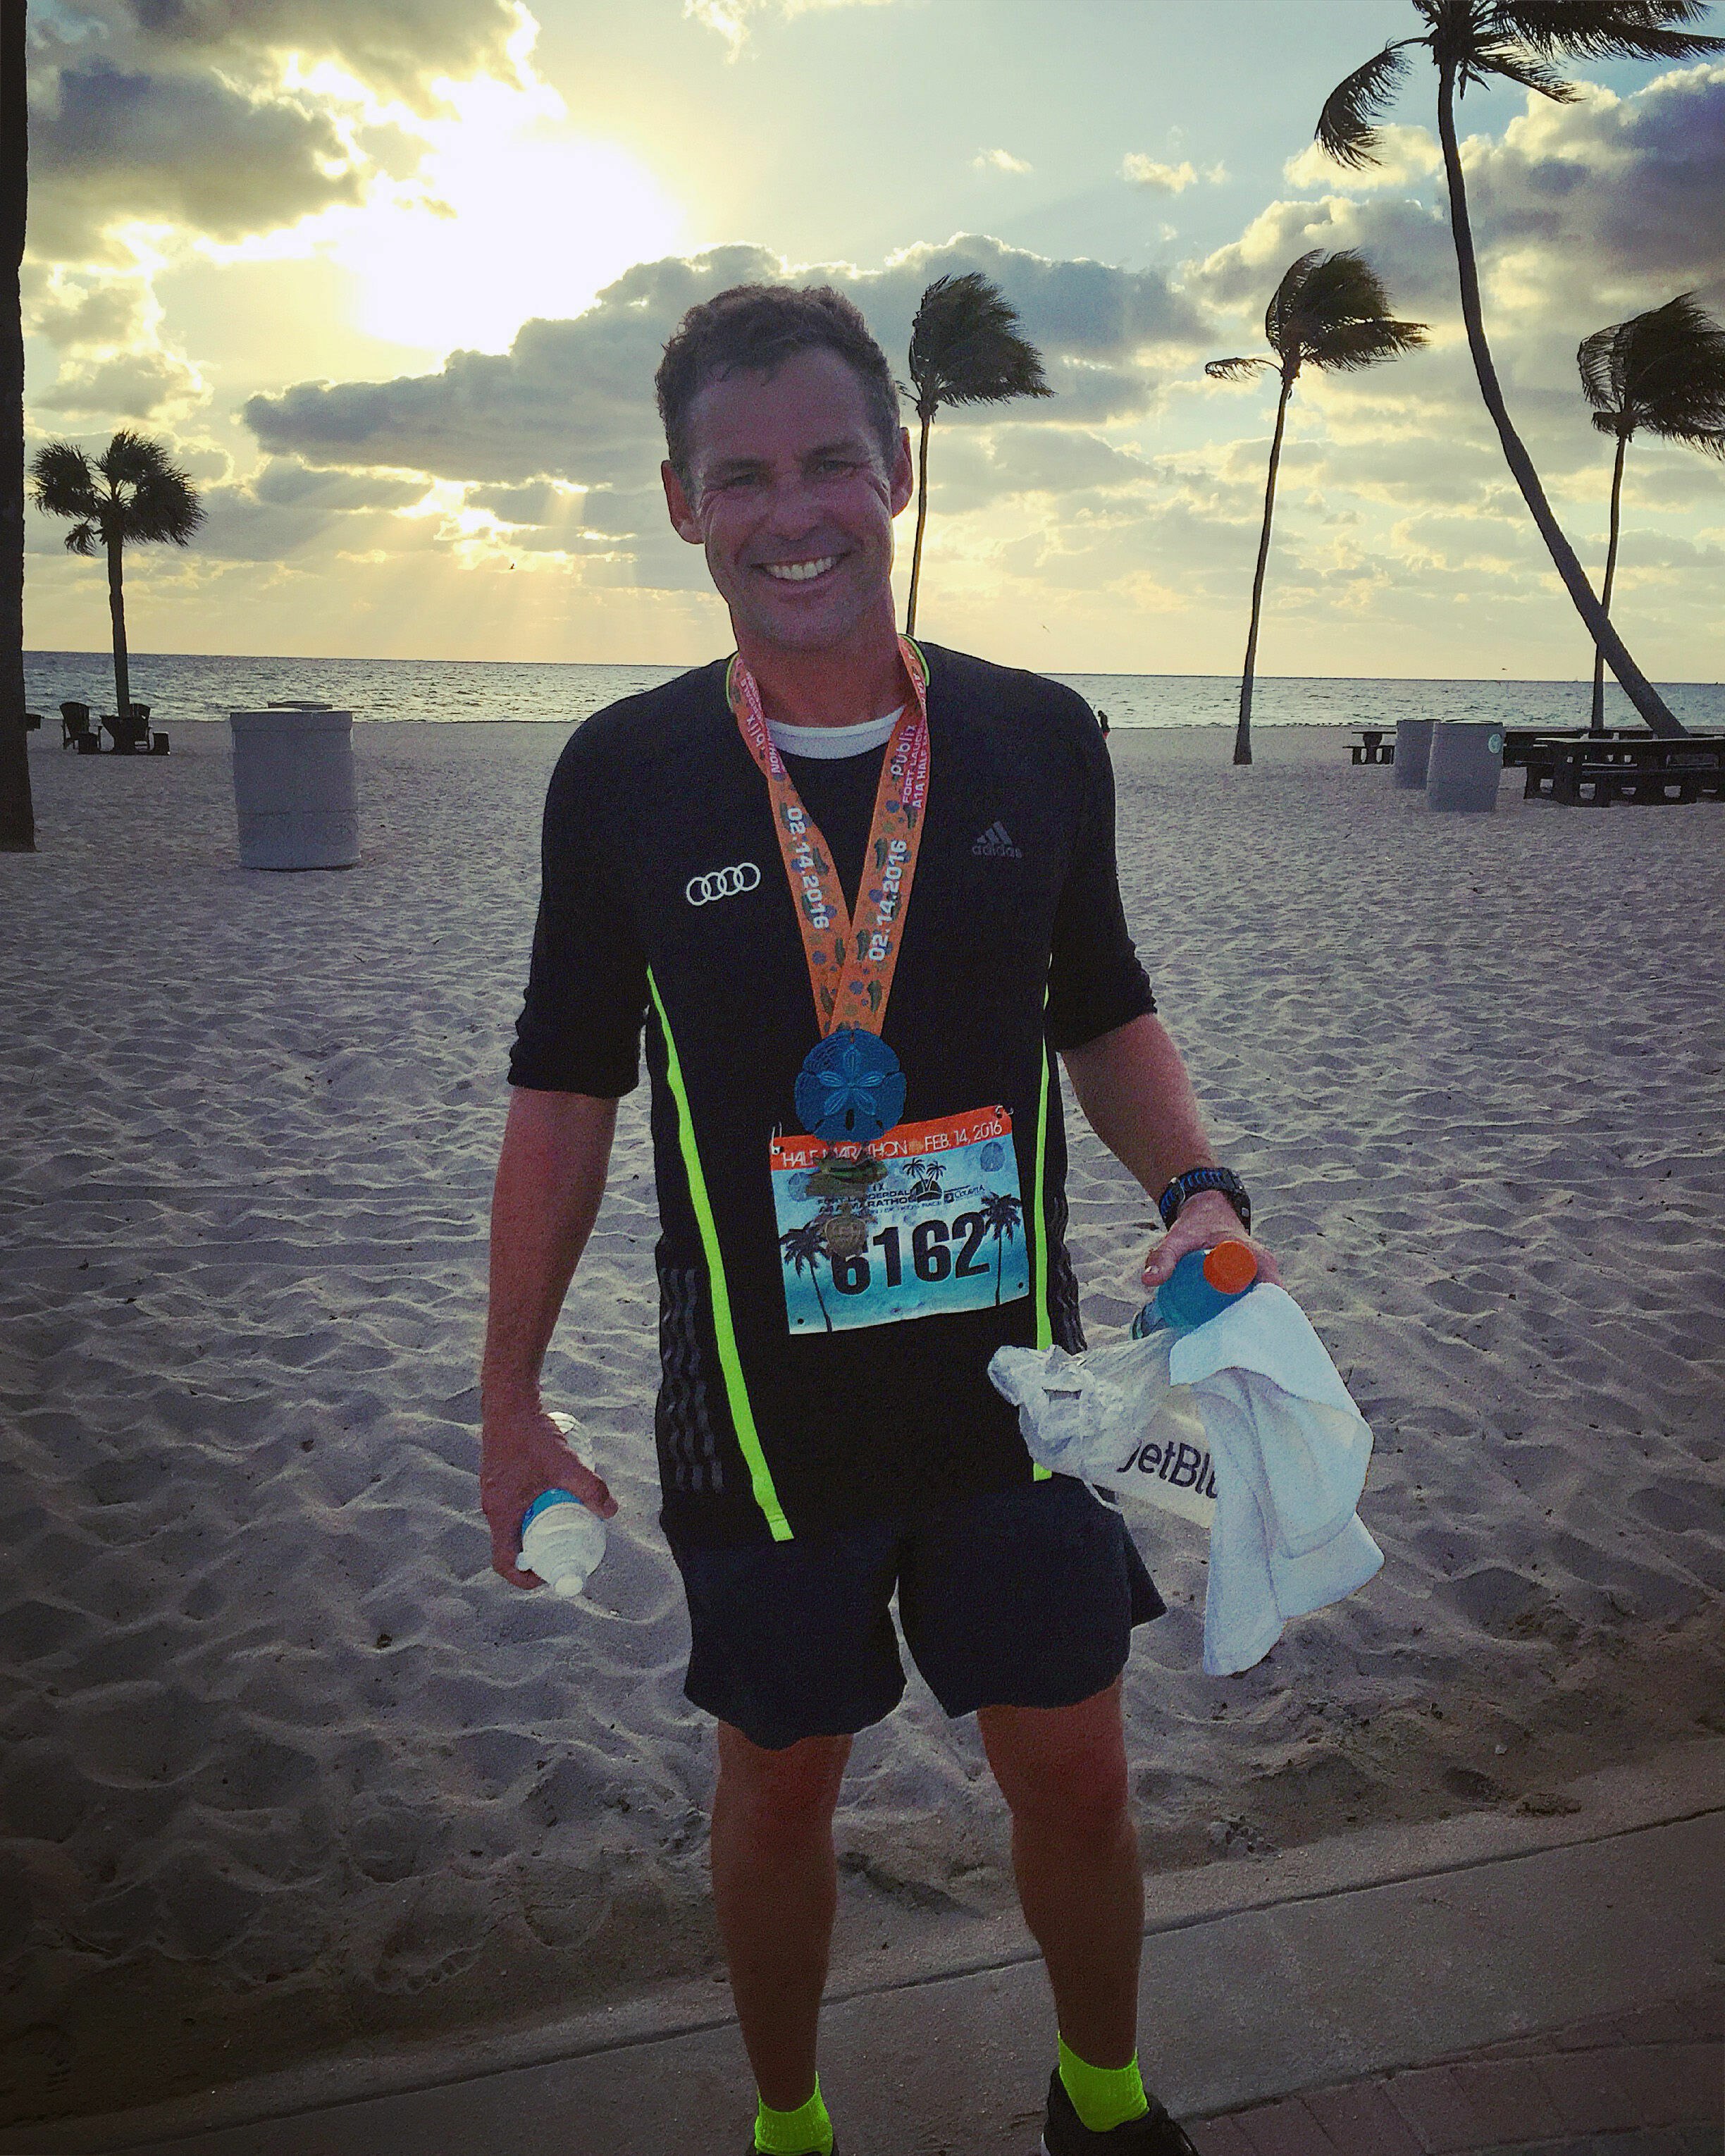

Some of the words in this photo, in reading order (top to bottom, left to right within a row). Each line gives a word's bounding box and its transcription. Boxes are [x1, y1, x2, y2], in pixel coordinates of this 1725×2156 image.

[903, 770, 915, 803] FORT
[913, 782, 925, 809] A1A
[787, 806, 829, 930] 02.14.2016
[868, 839, 907, 961] 02.14.2016
[973, 1120, 1003, 1141] 2016
[831, 1211, 991, 1295] 6162
